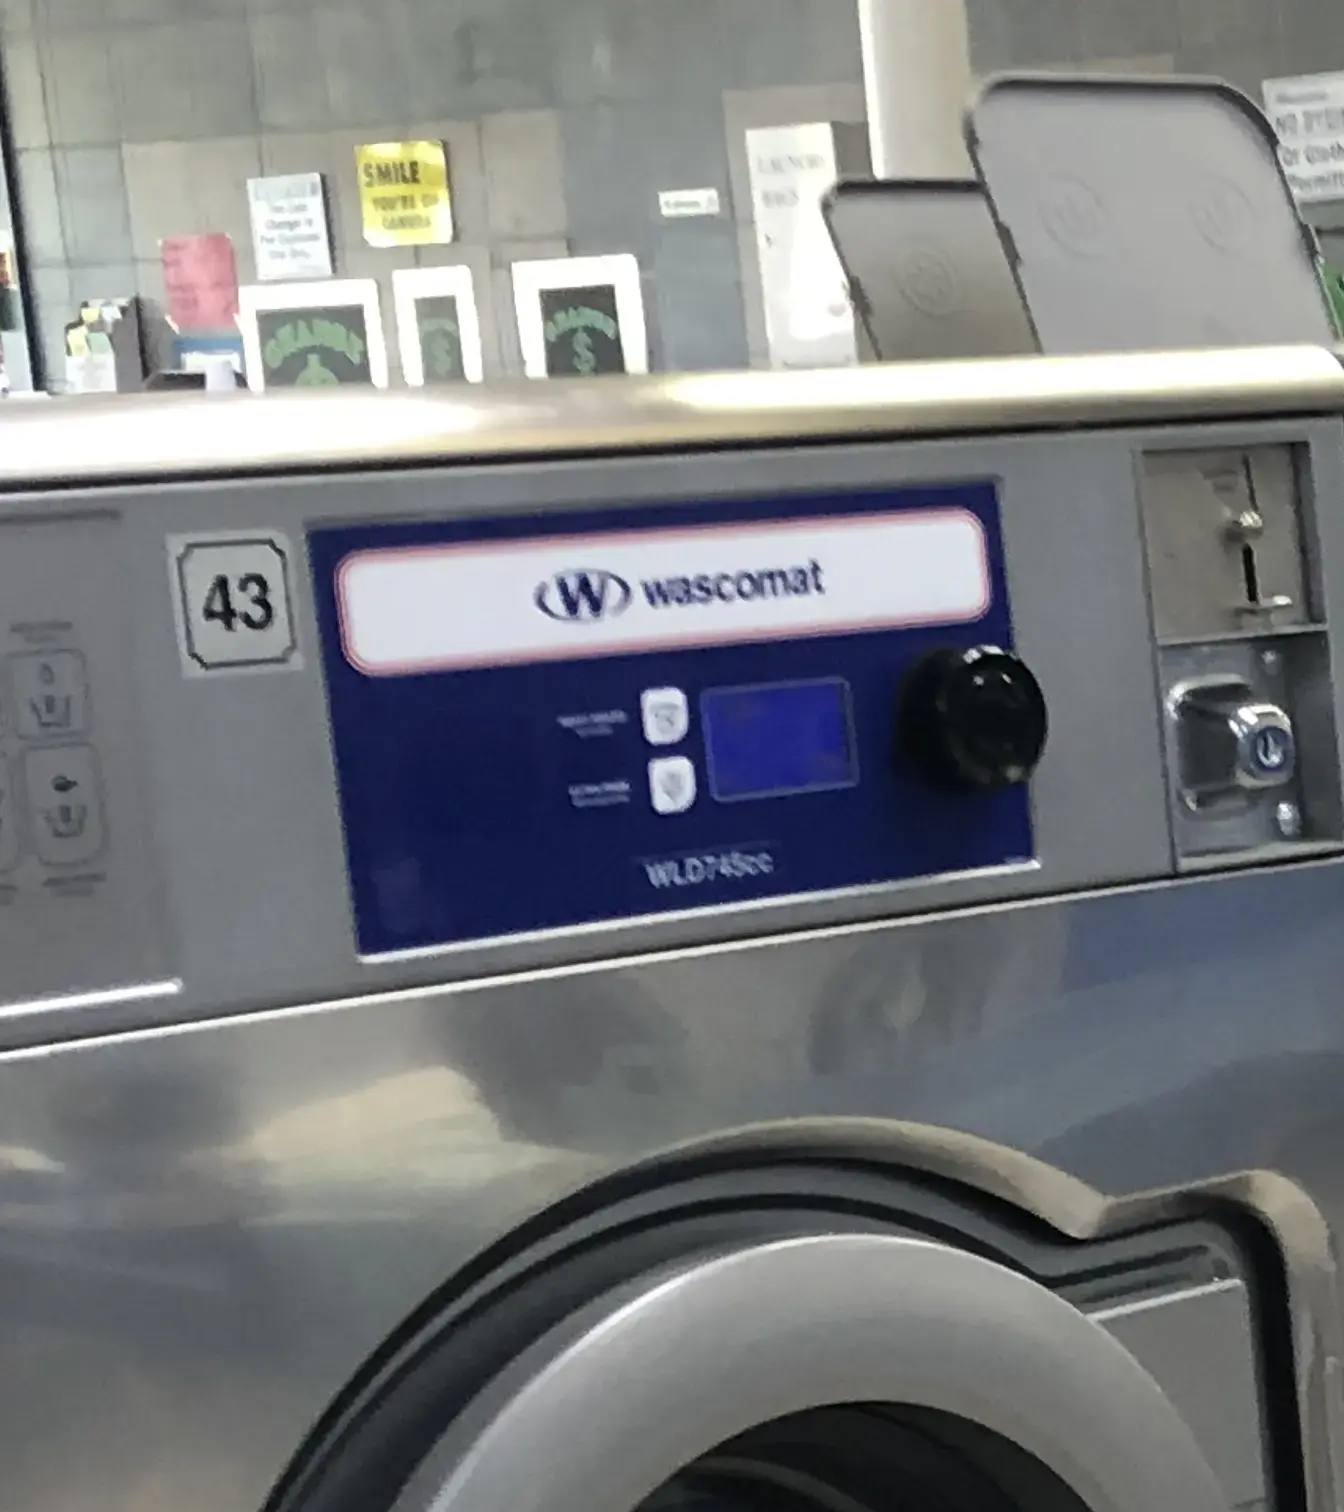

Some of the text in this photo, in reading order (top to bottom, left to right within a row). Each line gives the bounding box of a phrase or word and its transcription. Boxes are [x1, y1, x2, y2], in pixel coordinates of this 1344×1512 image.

[362, 159, 421, 188] SMILE
[202, 572, 274, 633] 43
[640, 556, 827, 610] wascomat
